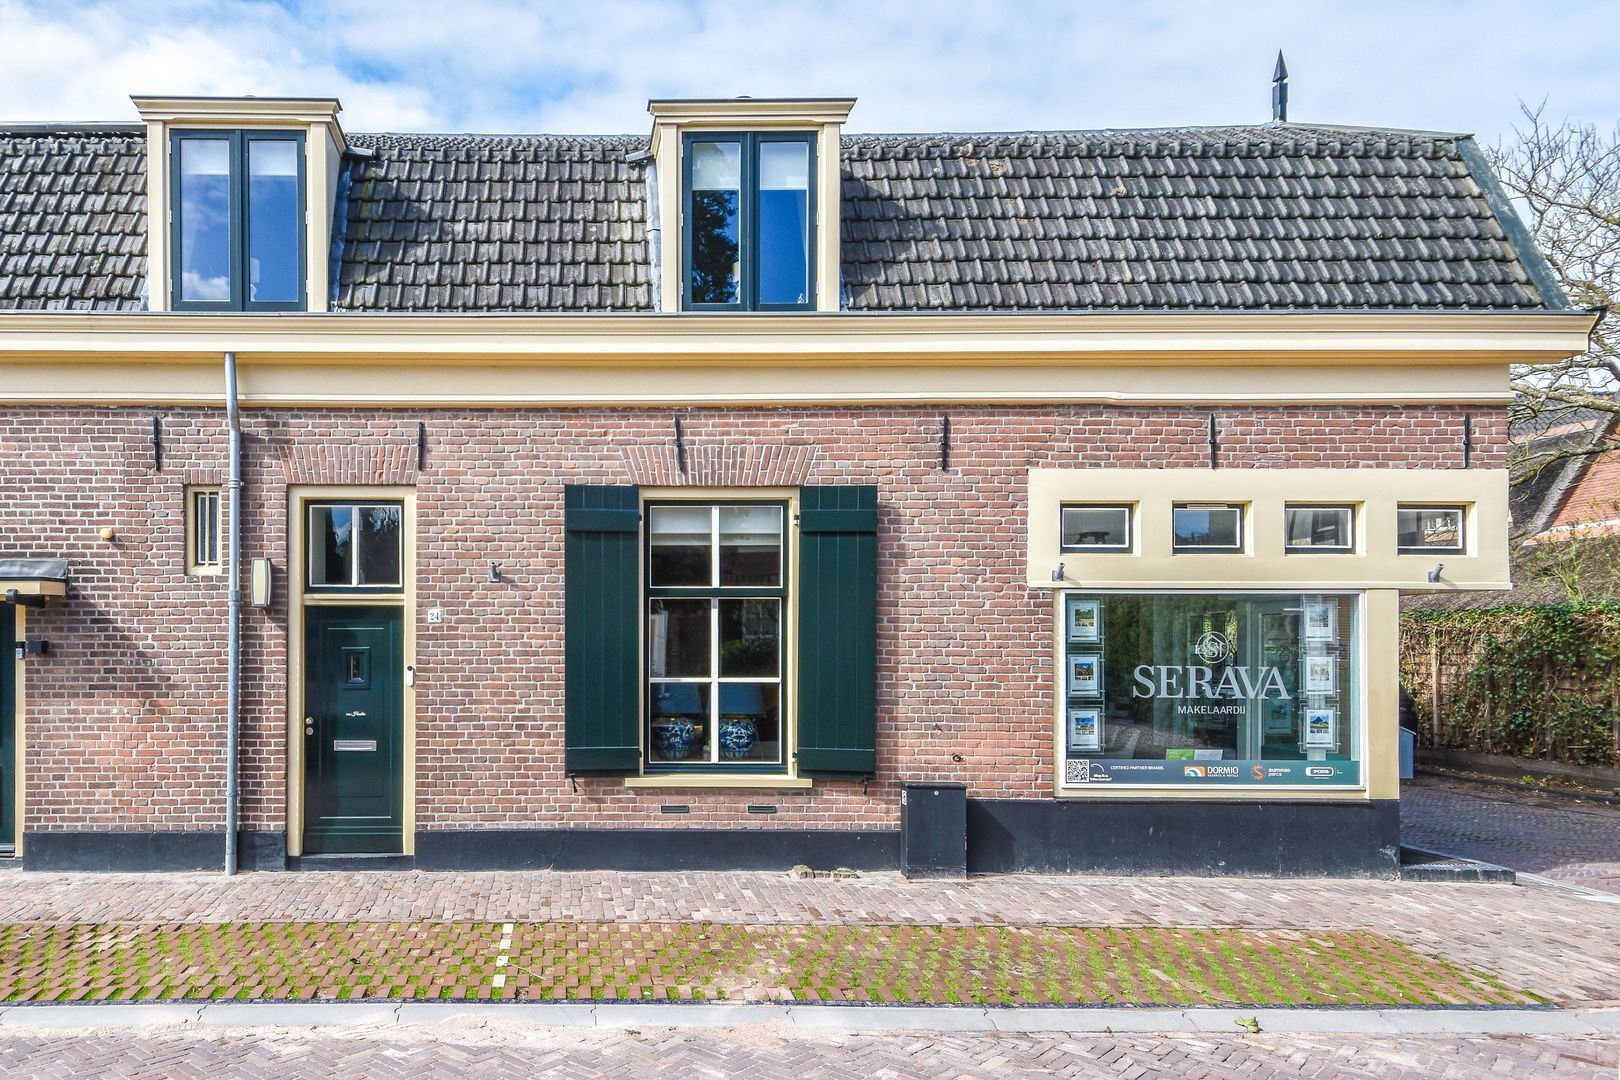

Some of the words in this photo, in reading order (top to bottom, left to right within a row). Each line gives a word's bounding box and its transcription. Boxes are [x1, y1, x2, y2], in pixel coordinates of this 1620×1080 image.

[1132, 664, 1292, 699] SERAVA
[1177, 705, 1246, 715] MAKELAARDIJ
[1207, 766, 1239, 774] DORMIO
